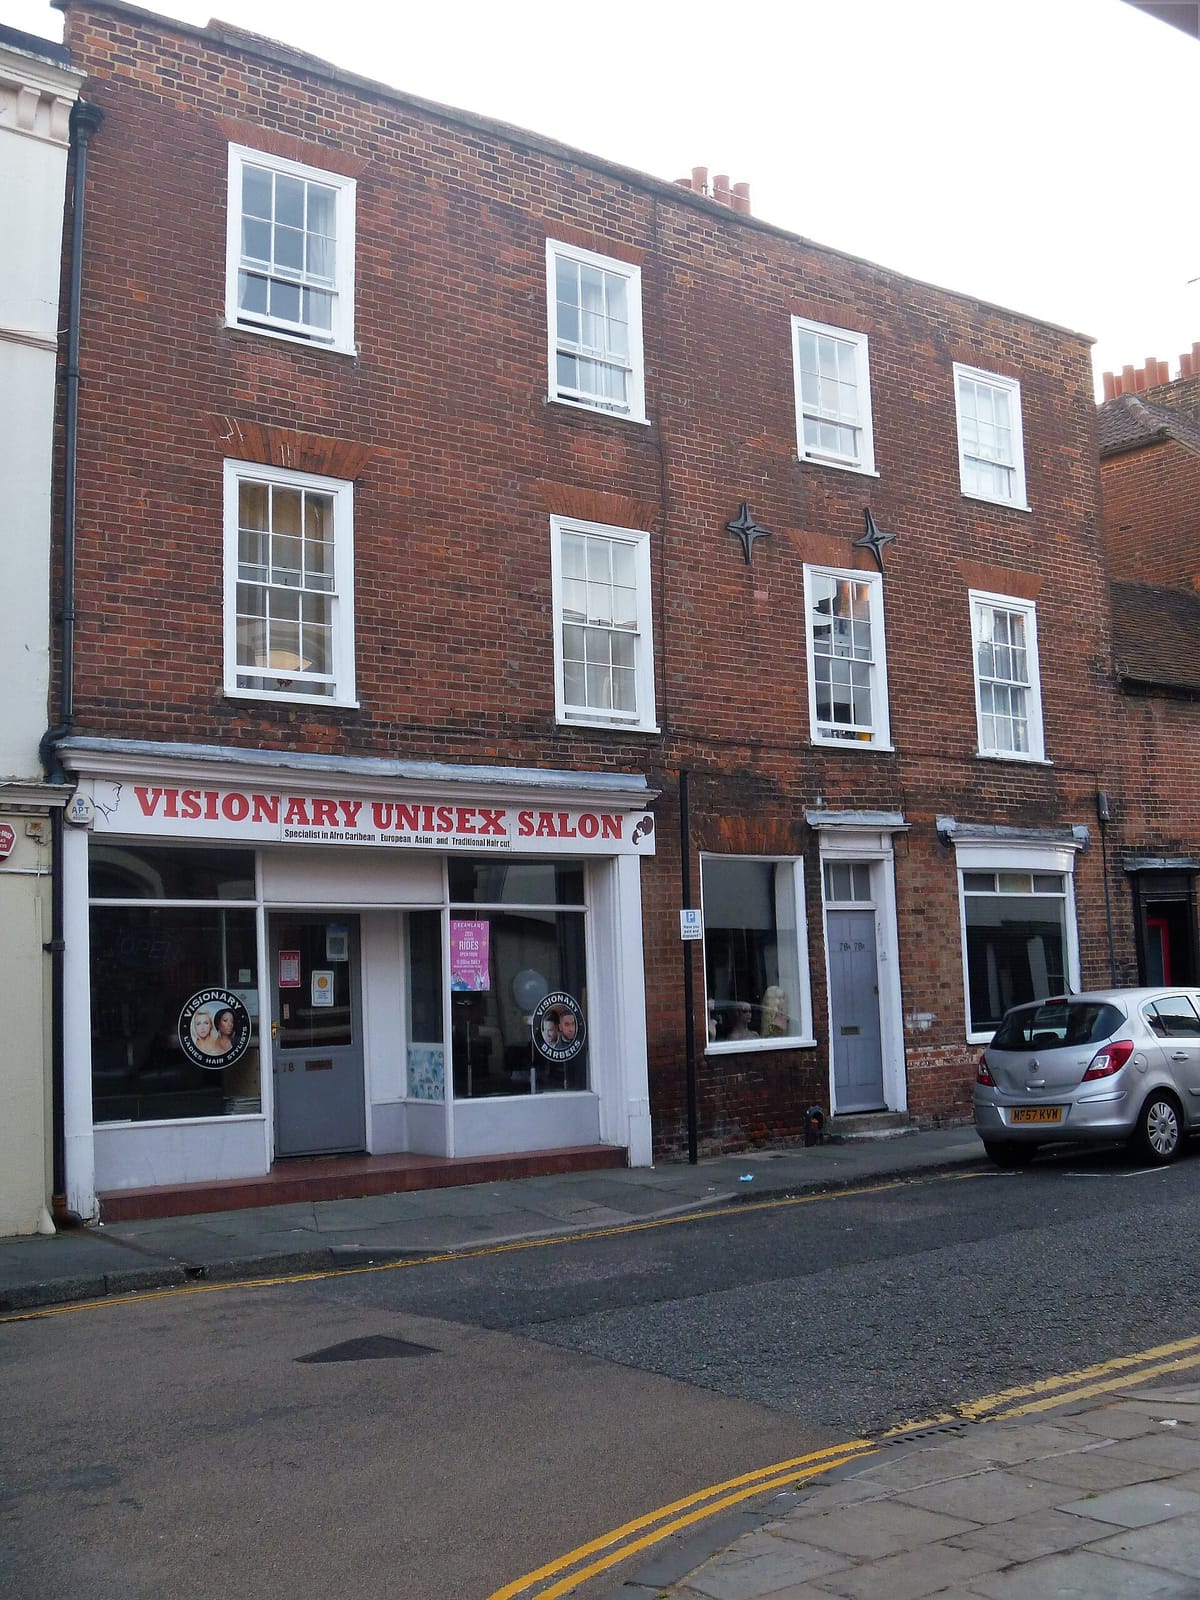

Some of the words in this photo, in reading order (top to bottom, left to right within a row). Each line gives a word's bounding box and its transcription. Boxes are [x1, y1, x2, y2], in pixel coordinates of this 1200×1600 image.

[72, 806, 90, 815] APT
[134, 786, 363, 828] VISIONARY
[372, 802, 507, 836] UNISEX
[518, 811, 623, 840] SALON
[284, 829, 320, 839] Specialist
[321, 831, 329, 839] in
[329, 831, 344, 840] Afro
[380, 833, 412, 844] European
[415, 835, 433, 845] Asian
[436, 836, 449, 845] and
[452, 837, 485, 847] Traditional
[459, 940, 479, 951] RIDES
[184, 991, 242, 1017] VISIONARY
[537, 994, 579, 1016] VISIONARY
[184, 1036, 203, 1061] LADIES
[227, 1026, 248, 1060] STYLISTS
[541, 1040, 580, 1059] BARBERS
